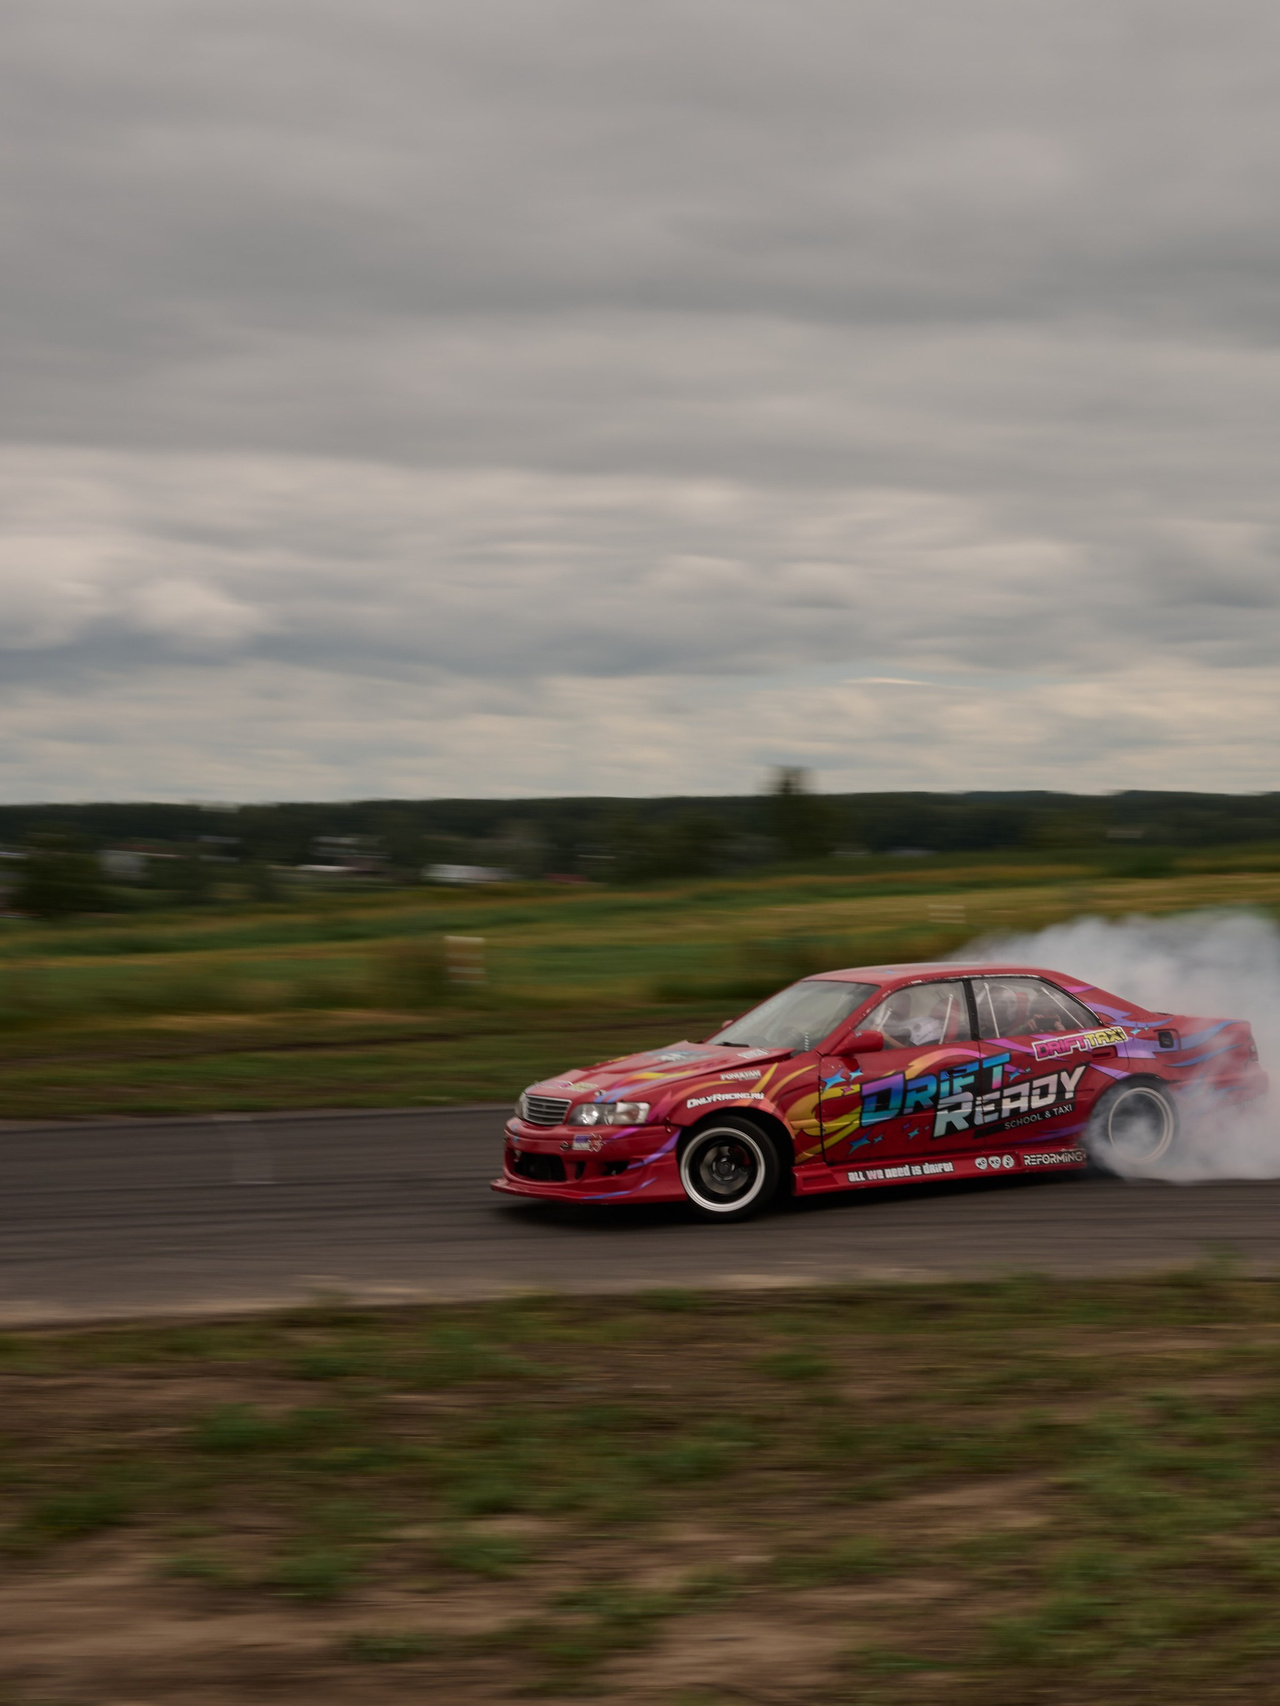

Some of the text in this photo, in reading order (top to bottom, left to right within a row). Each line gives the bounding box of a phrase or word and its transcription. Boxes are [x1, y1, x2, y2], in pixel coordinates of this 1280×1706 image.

[1003, 1103, 1073, 1130] SCHOOL & TAXI
